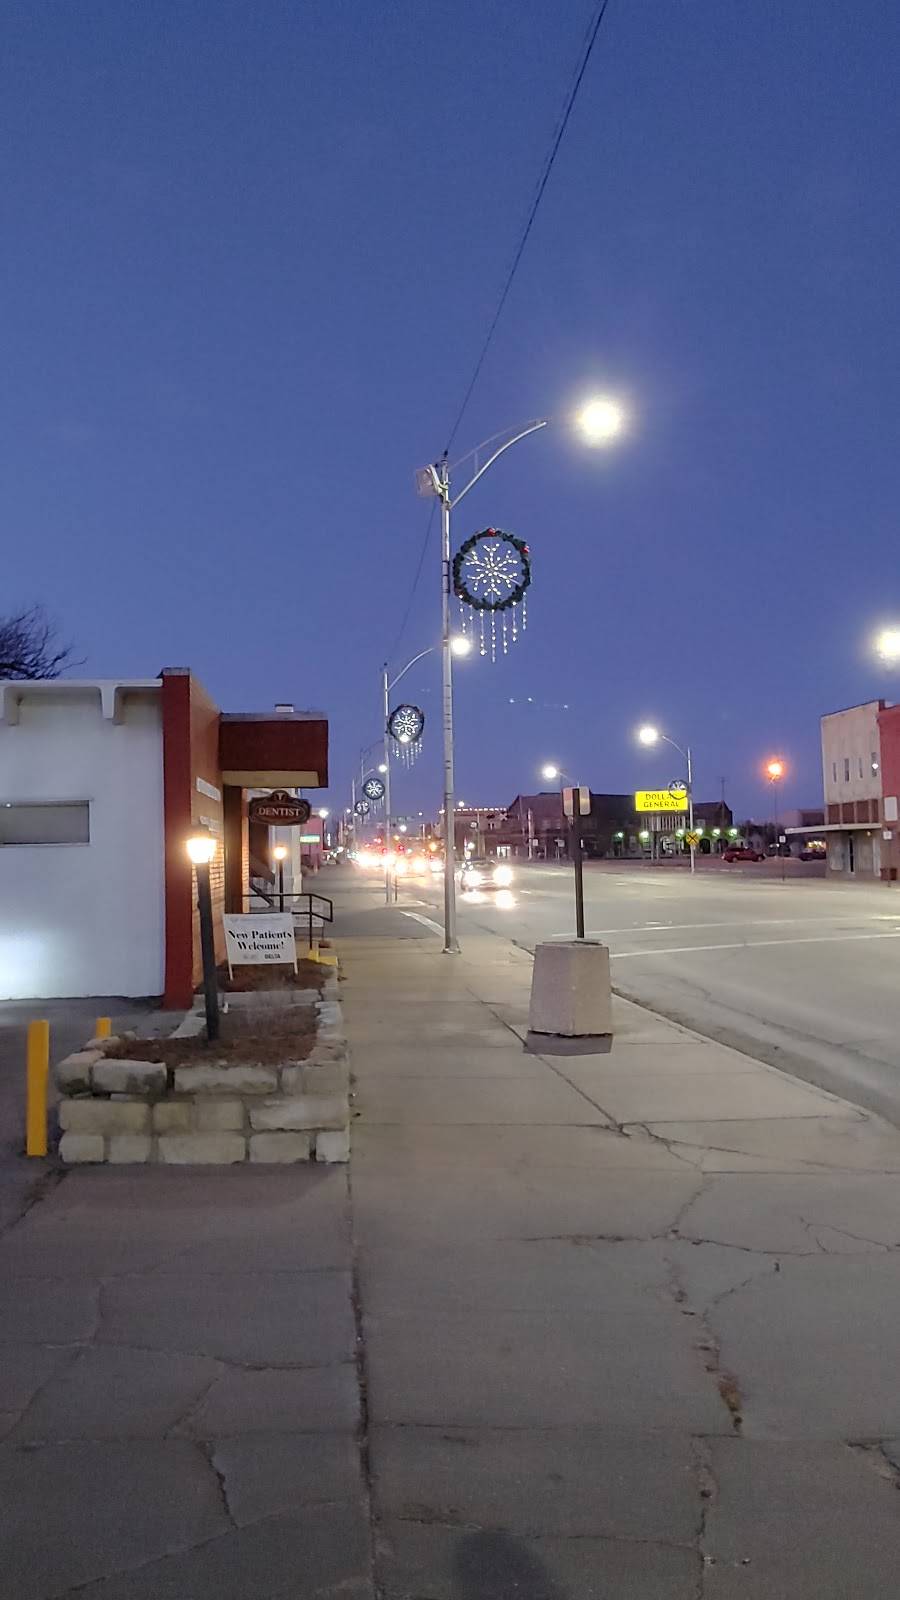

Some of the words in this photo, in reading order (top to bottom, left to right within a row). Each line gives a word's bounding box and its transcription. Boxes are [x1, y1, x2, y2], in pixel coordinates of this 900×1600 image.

[258, 807, 300, 816] DENTIST
[228, 930, 248, 939] New
[252, 930, 292, 939] Patients
[238, 941, 284, 950] Welcome!
